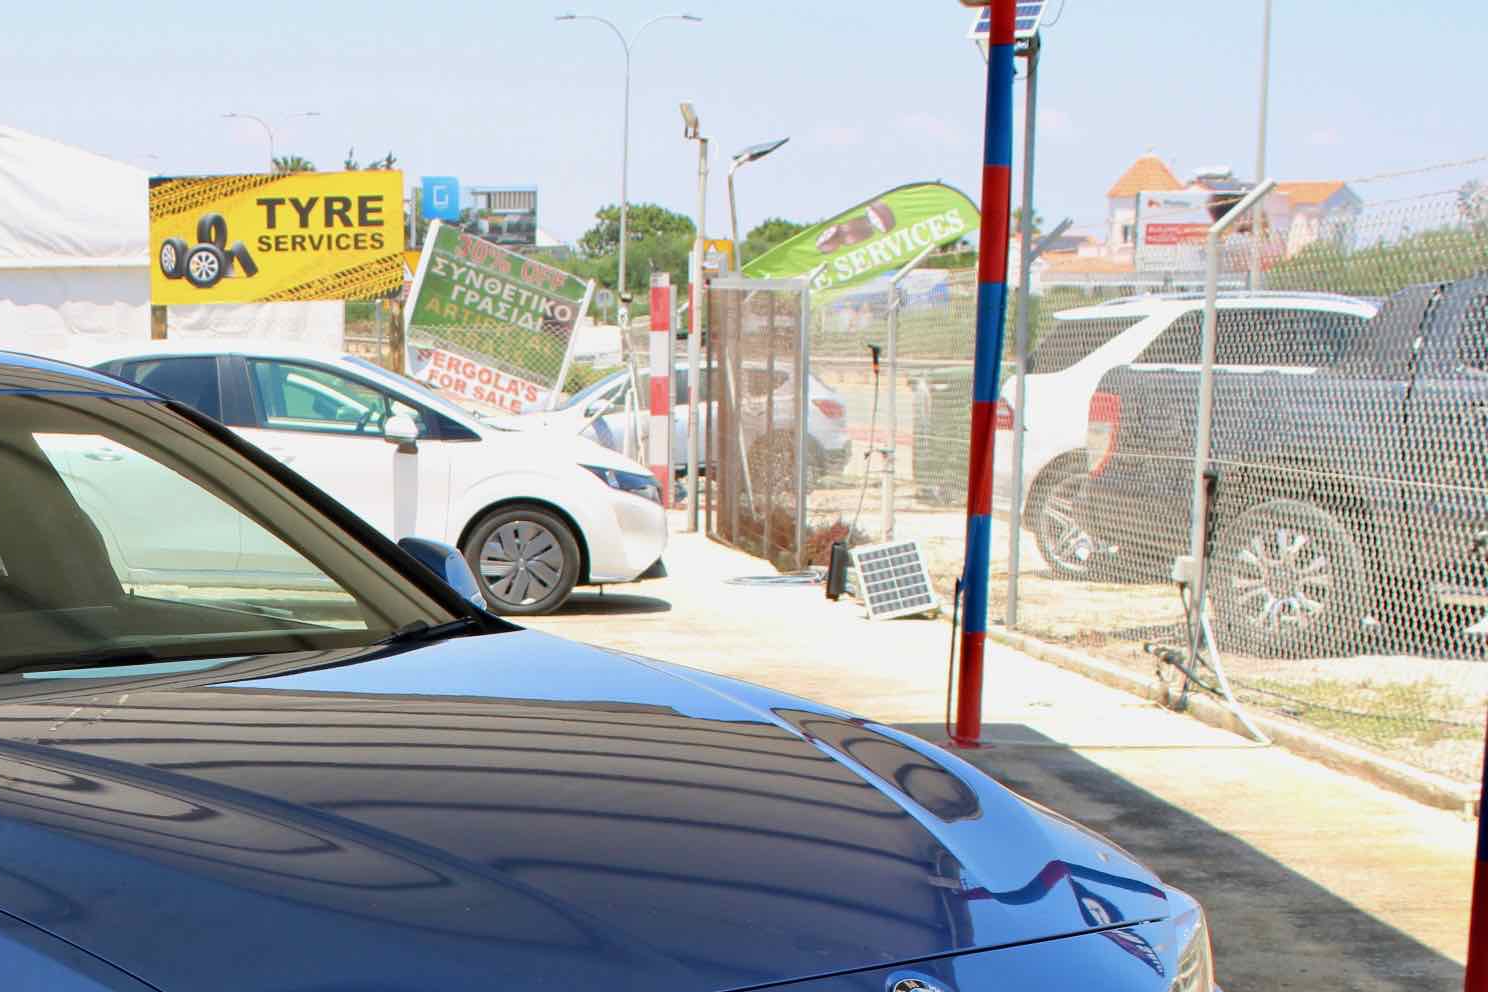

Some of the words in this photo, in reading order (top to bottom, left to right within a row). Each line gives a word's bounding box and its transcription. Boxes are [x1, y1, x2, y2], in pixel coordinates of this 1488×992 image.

[256, 195, 384, 229] TYRE
[257, 232, 384, 252] SERVICES
[833, 208, 965, 281] SERVICES
[431, 256, 572, 321] ΣΥΝΘΕΤΙΚΟ
[416, 349, 538, 402] PERGOLA'S
[428, 369, 467, 393] FOR
[473, 385, 522, 414] SALE
